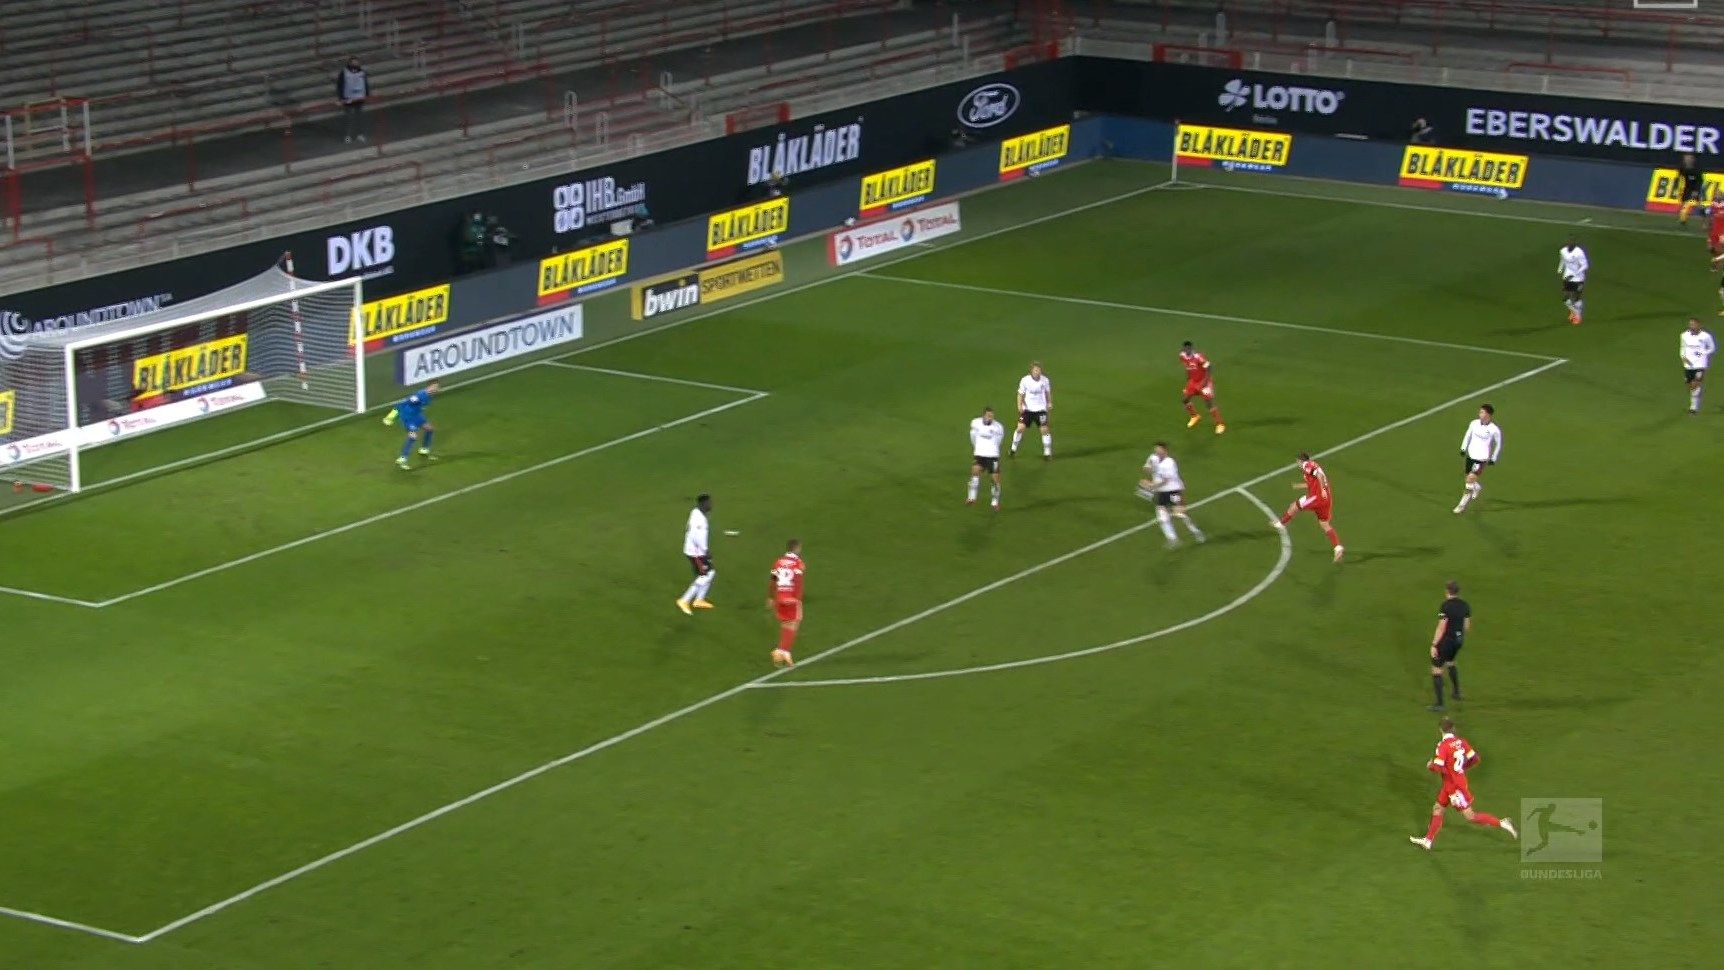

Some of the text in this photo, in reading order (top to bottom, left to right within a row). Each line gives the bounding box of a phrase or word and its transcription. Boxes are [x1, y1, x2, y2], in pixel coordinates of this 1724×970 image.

[969, 91, 1009, 122] Ford
[1253, 84, 1338, 115] LOTTO
[1180, 129, 1285, 161] BLÅKLÄDER
[1465, 107, 1720, 155] EBERSWALDER
[747, 122, 862, 186] BLÅKLÄDER
[1407, 151, 1521, 184] BLÅKLÄDER
[327, 225, 395, 276] DKB
[644, 279, 698, 316] bwin
[414, 313, 576, 379] AROUNDTOWN
